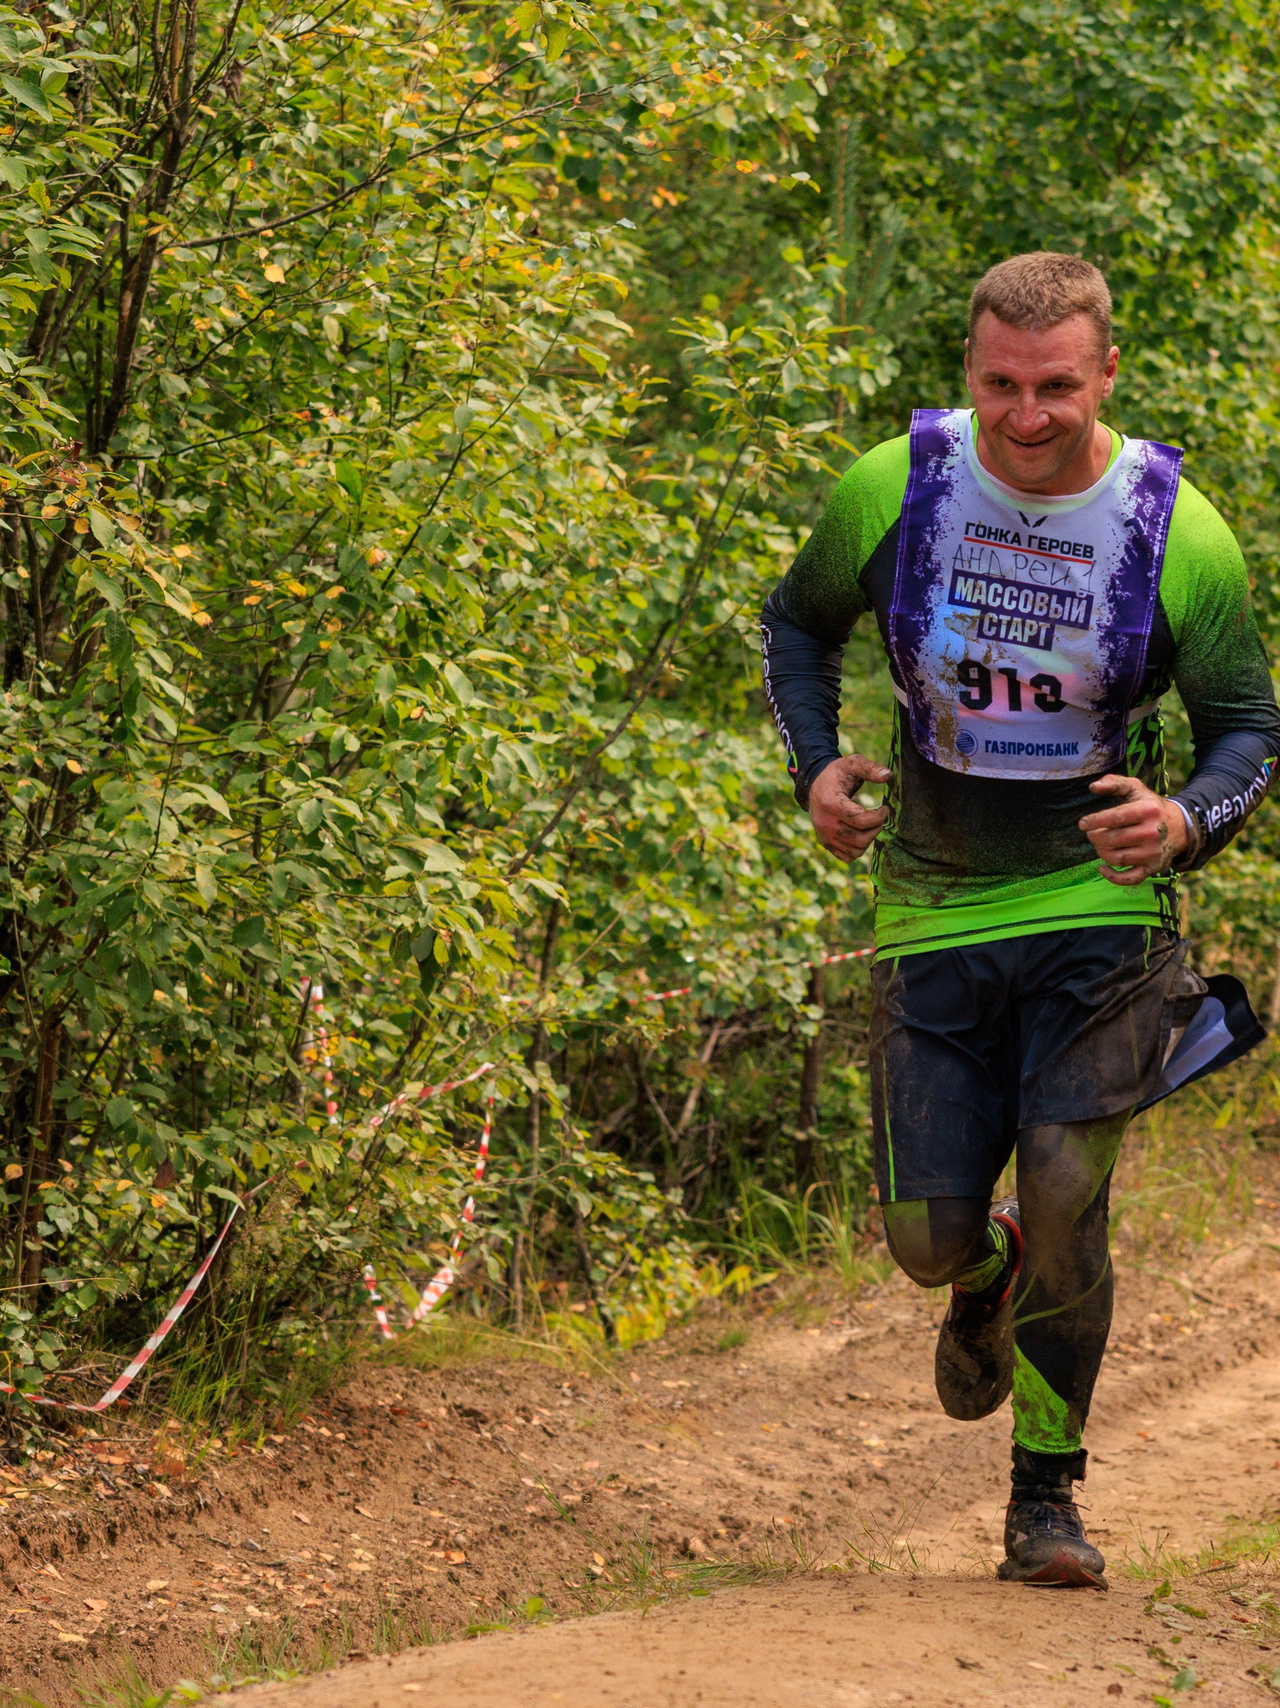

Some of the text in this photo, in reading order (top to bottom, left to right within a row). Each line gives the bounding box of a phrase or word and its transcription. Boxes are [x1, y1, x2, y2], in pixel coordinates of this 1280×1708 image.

[964, 521, 1095, 559] ГОНКА ГЕРОЕВ
[954, 575, 1088, 624] МАССОВЫЙ
[982, 612, 1051, 647] СТАРТ
[984, 740, 1080, 757] ГАЗПРОМБАНК
